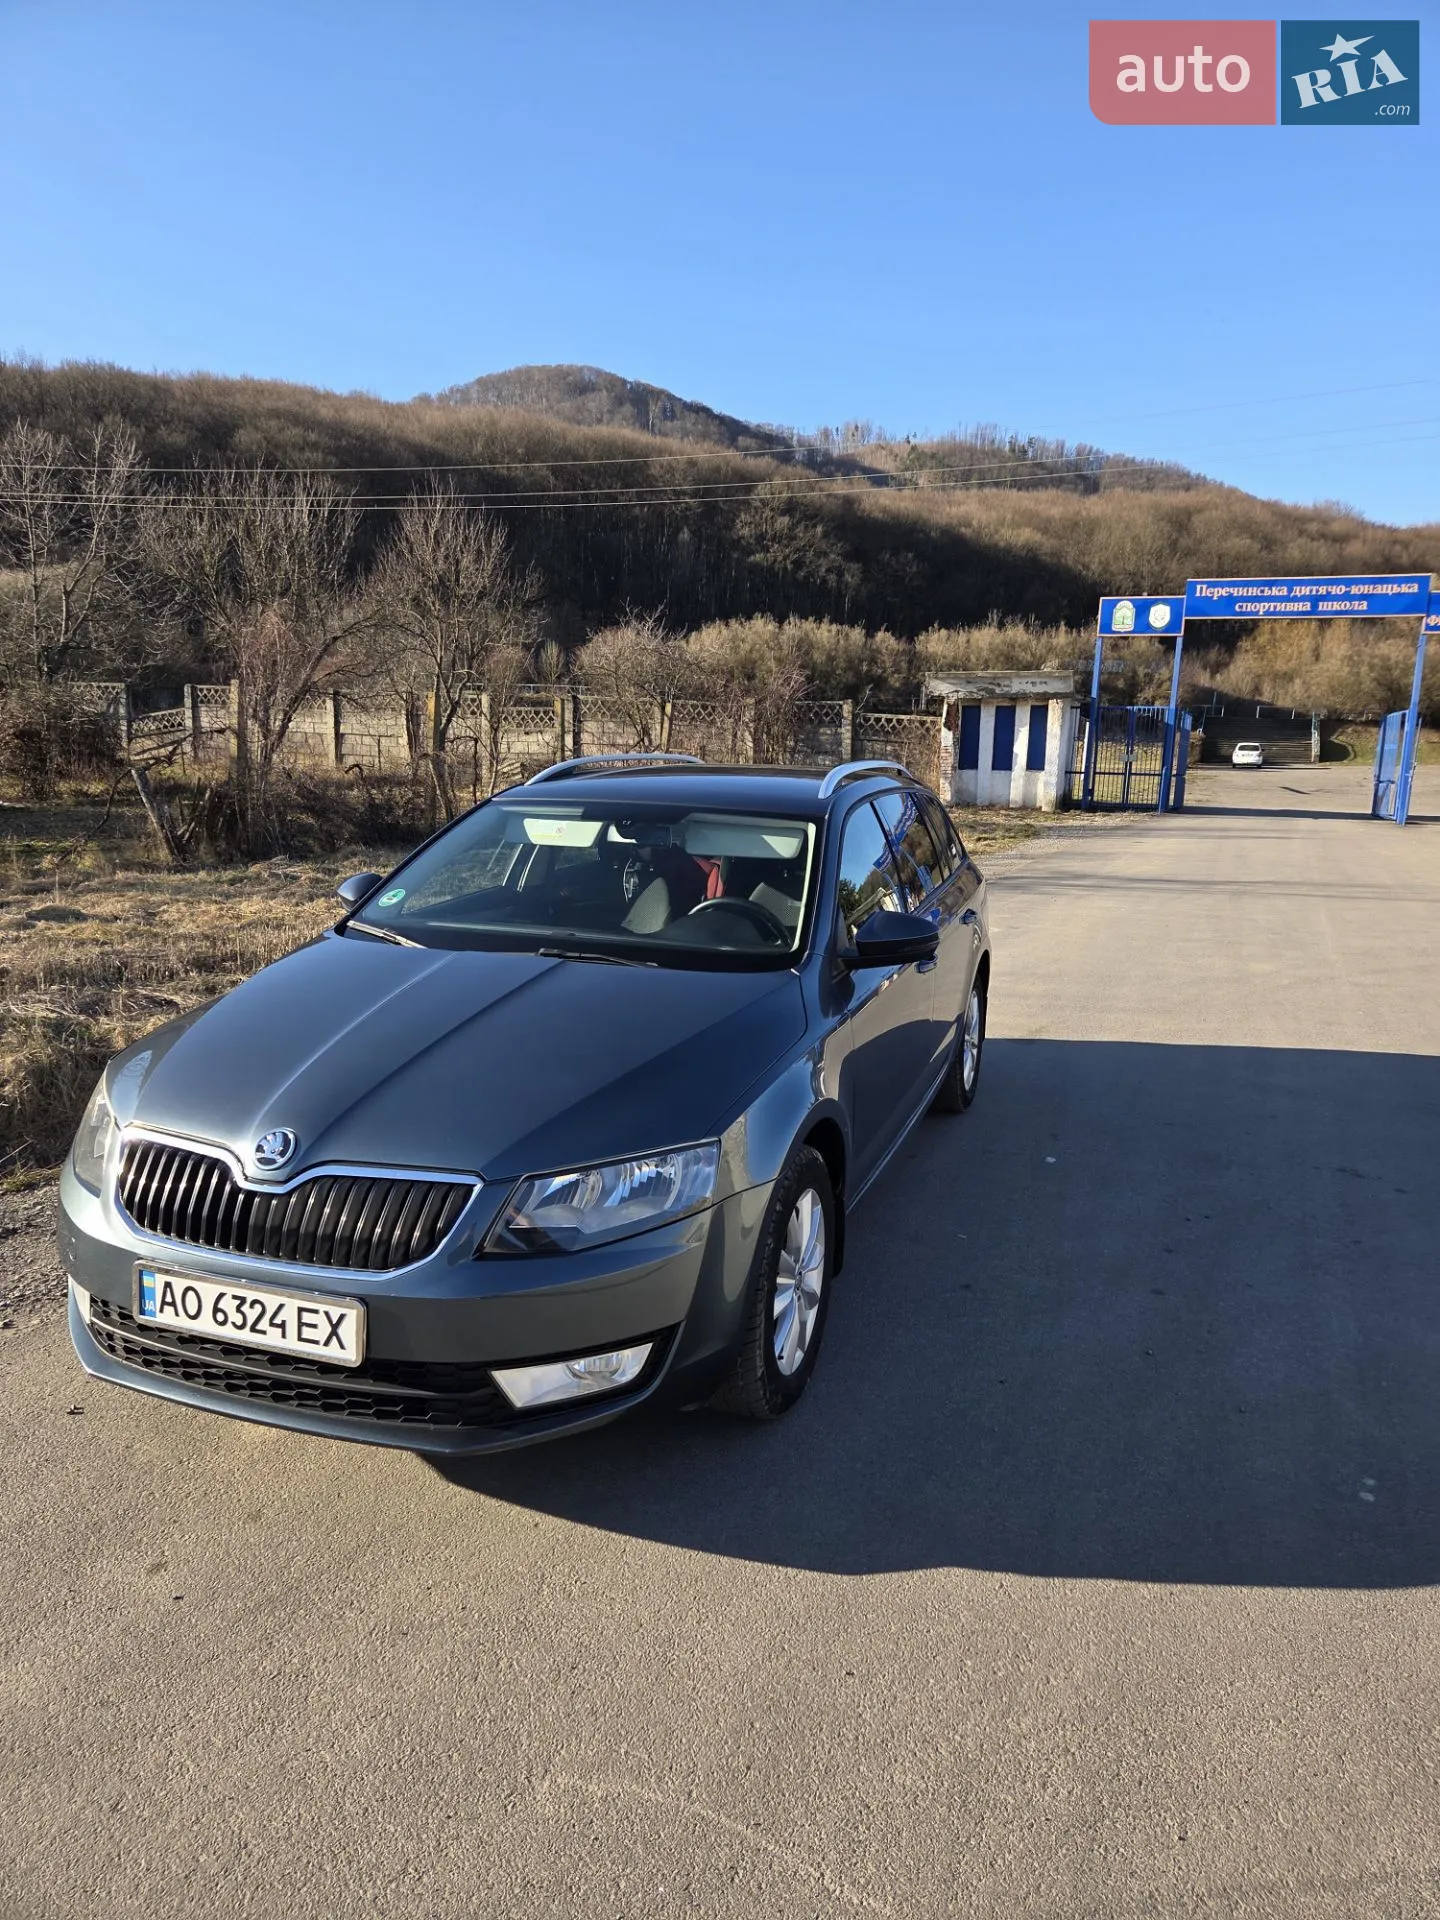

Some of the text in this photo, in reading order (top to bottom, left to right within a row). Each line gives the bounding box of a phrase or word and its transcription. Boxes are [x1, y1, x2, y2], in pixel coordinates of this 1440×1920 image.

[1195, 582, 1419, 600] Перечинська дитячо-юнацька
[1235, 600, 1368, 615] спортивна школа
[158, 1280, 348, 1351] AO 6324 EX
